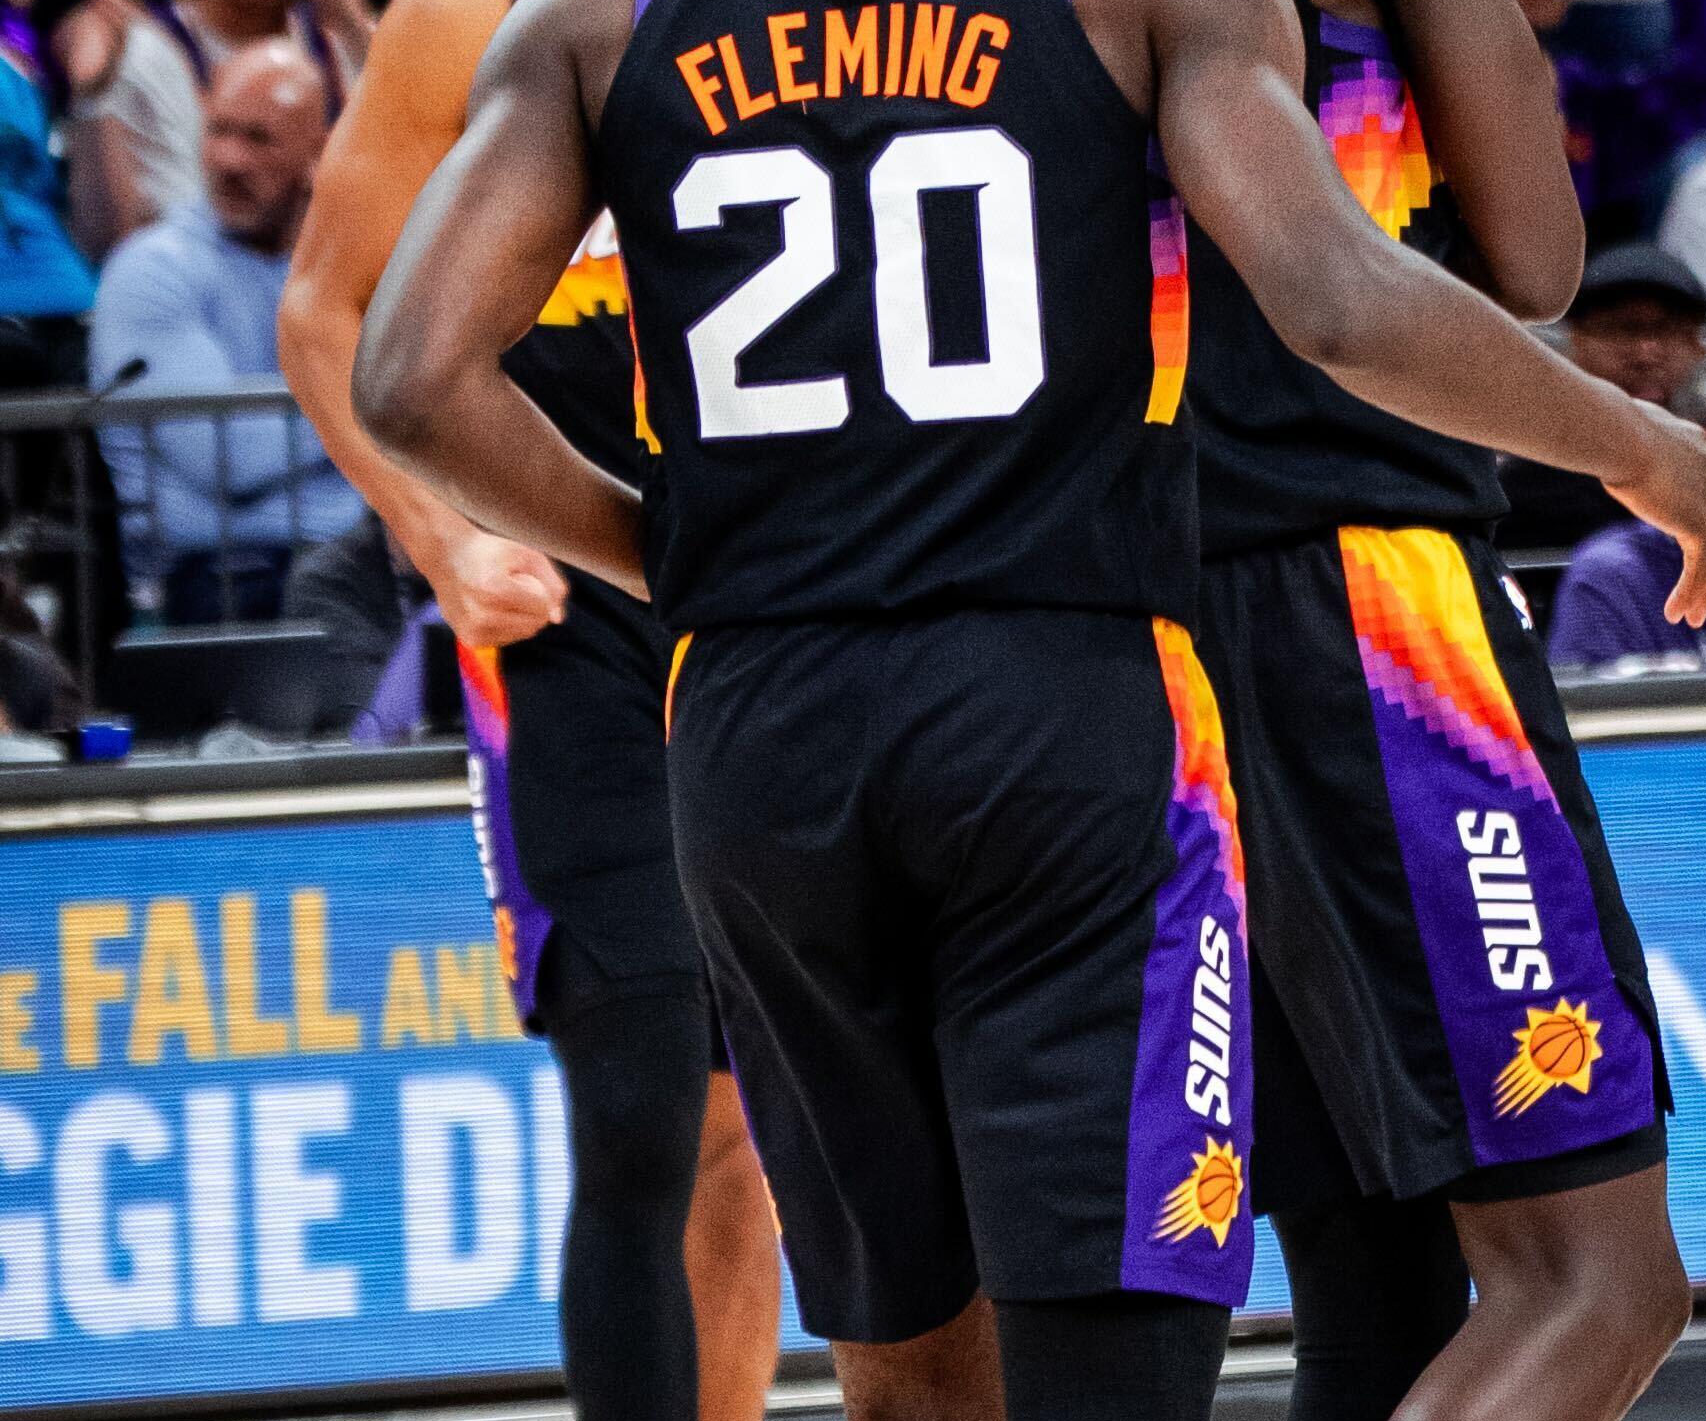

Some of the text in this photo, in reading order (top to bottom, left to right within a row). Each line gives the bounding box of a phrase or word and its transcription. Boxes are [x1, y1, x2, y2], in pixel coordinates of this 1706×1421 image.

[674, 2, 1011, 136] FLEMING
[671, 125, 1047, 442] 20
[60, 887, 362, 1070] FALL
[1455, 809, 1554, 992] SUNS
[1184, 914, 1232, 1127] SUNS
